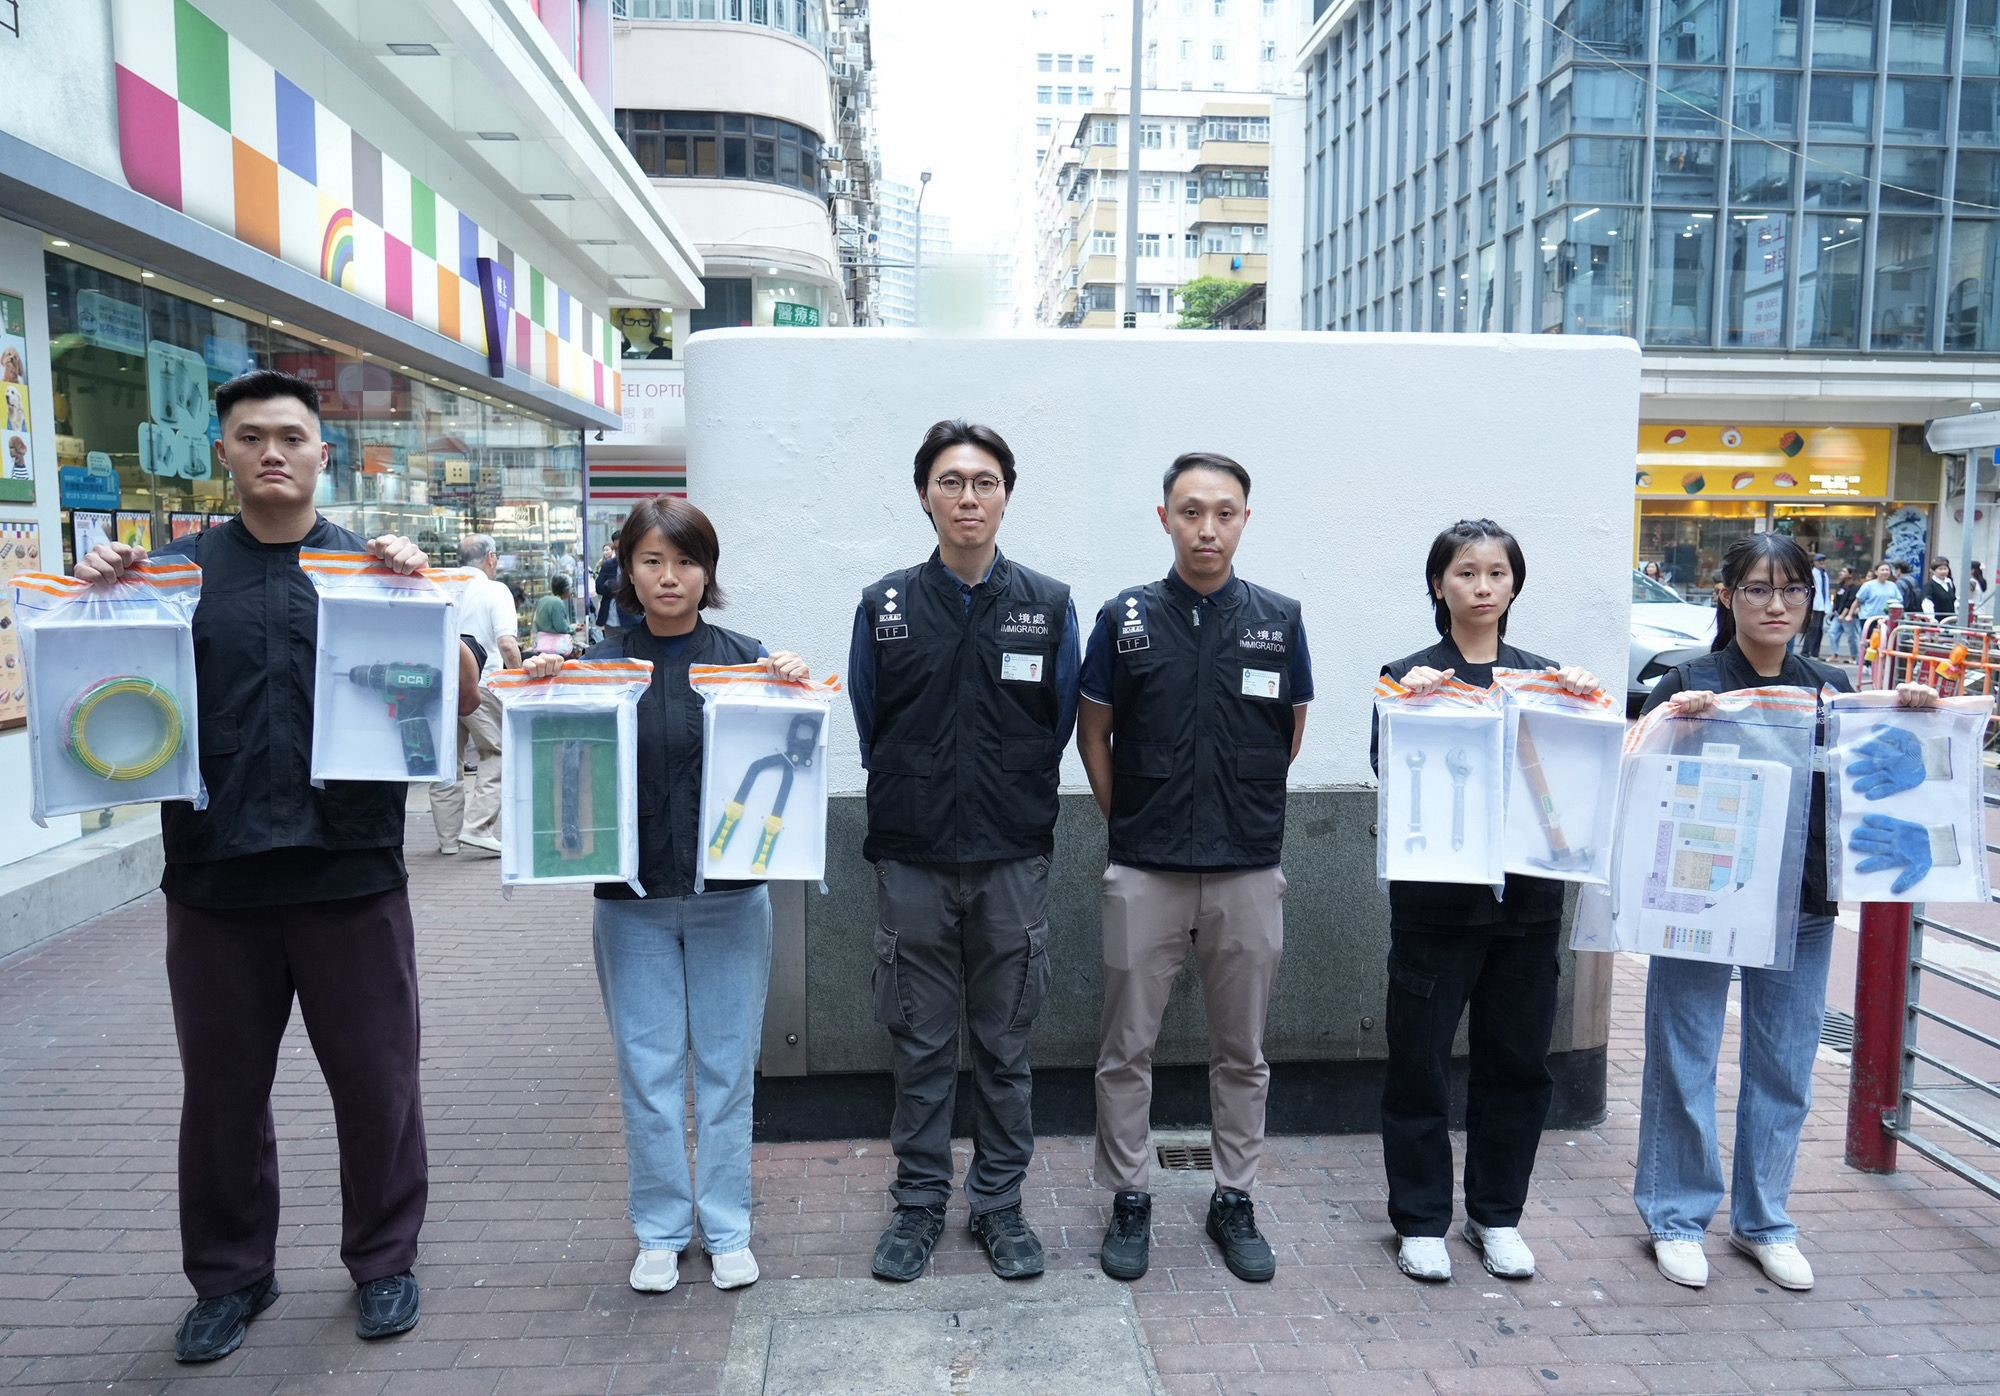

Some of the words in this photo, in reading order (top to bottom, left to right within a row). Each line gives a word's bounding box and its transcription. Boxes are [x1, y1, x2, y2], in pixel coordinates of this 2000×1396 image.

[777, 303, 818, 326] 醫療券
[1005, 611, 1046, 625] 入境處
[1000, 624, 1049, 635] IMMIGRATION
[1243, 628, 1284, 643] 入境處
[1239, 639, 1286, 653] IMMIGRATION
[398, 675, 425, 685] DCA
